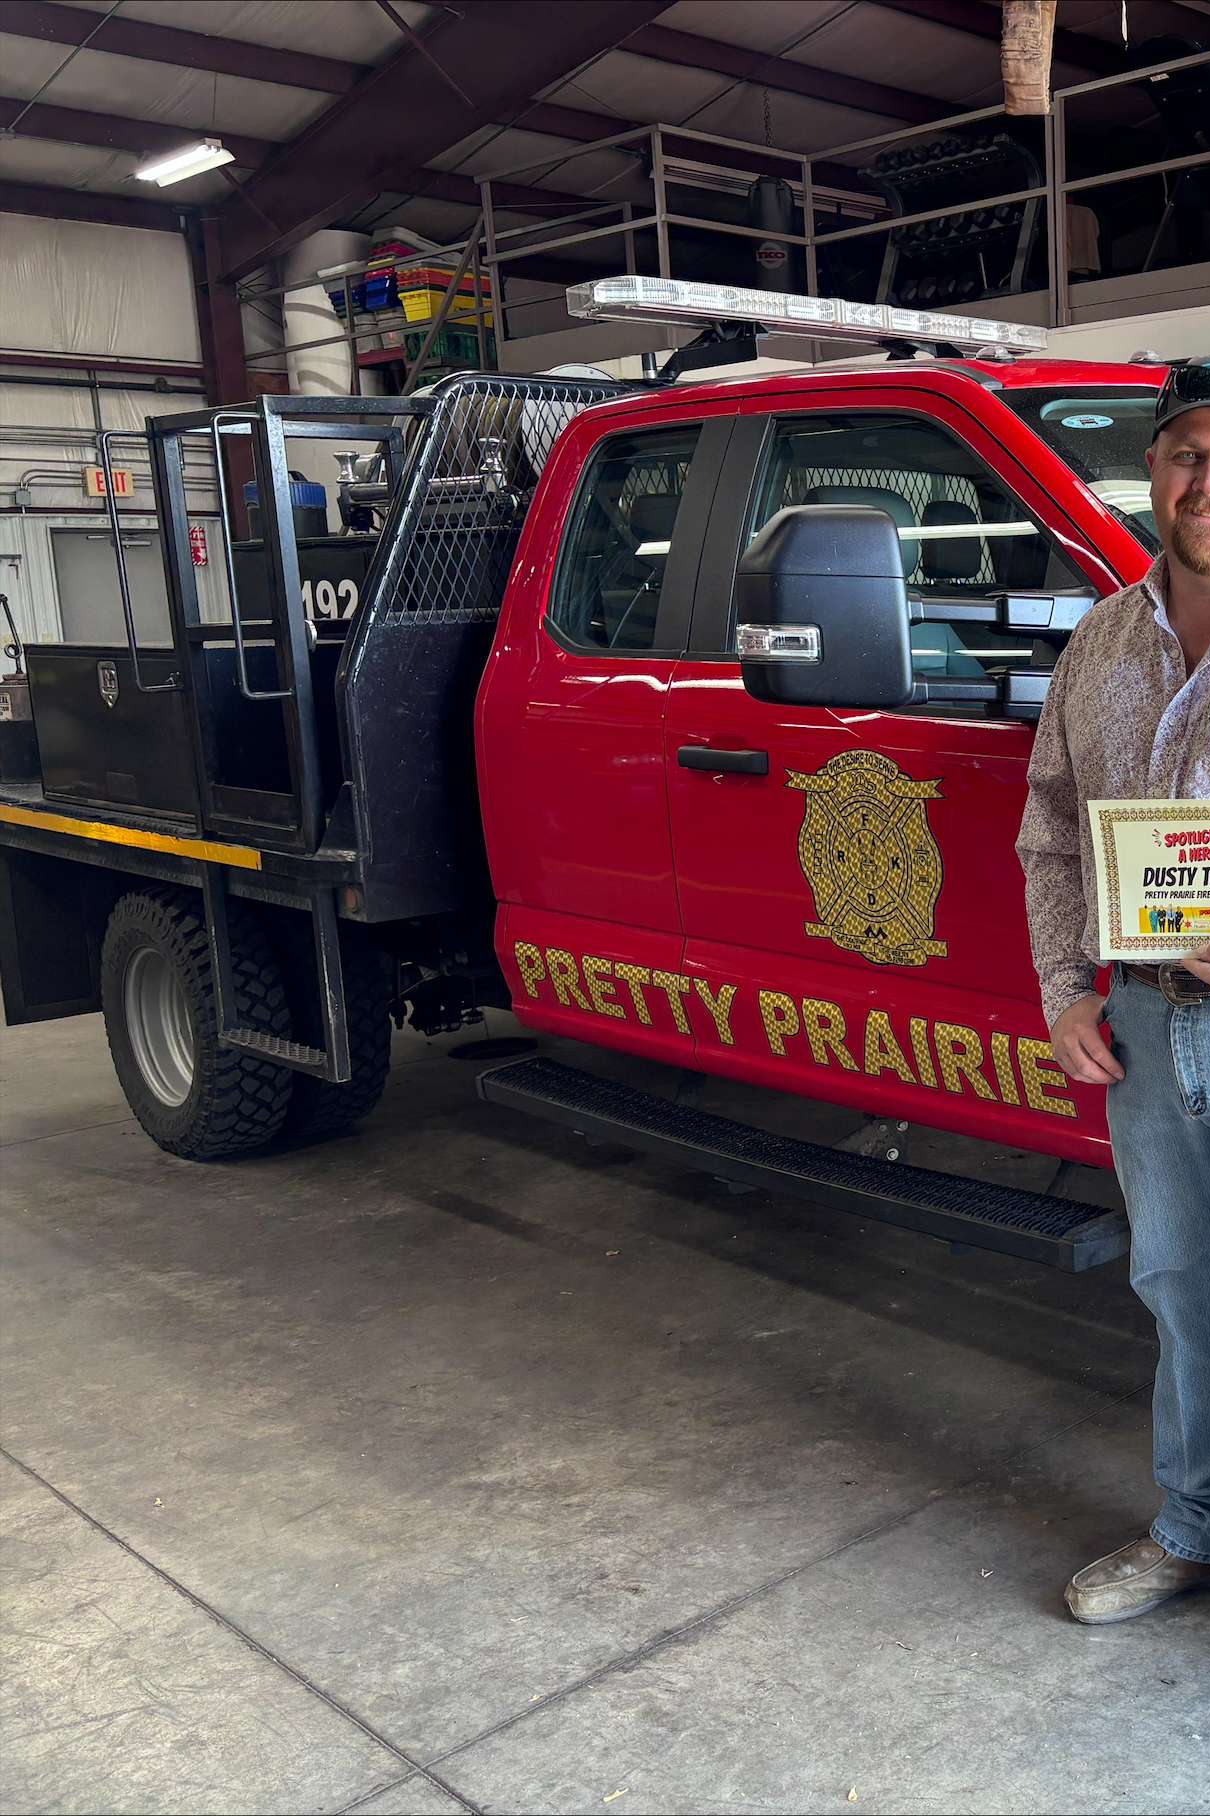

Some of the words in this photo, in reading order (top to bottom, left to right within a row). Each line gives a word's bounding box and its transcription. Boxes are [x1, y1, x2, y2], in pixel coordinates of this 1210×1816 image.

[96, 471, 126, 493] EIT
[301, 579, 359, 619] 192
[864, 754, 873, 764] TO
[862, 814, 869, 826] F
[838, 851, 845, 863] R
[892, 857, 901, 869] K
[1178, 849, 1187, 863] A
[1143, 867, 1197, 887] DUSTY
[868, 894, 875, 905] D
[1145, 891, 1168, 899] PRETTY
[1170, 891, 1196, 899] PRAIRIE
[1197, 890, 1210, 899] FIRE
[514, 940, 738, 1046] PRETTY
[759, 989, 1078, 1118] PRAIRIE
